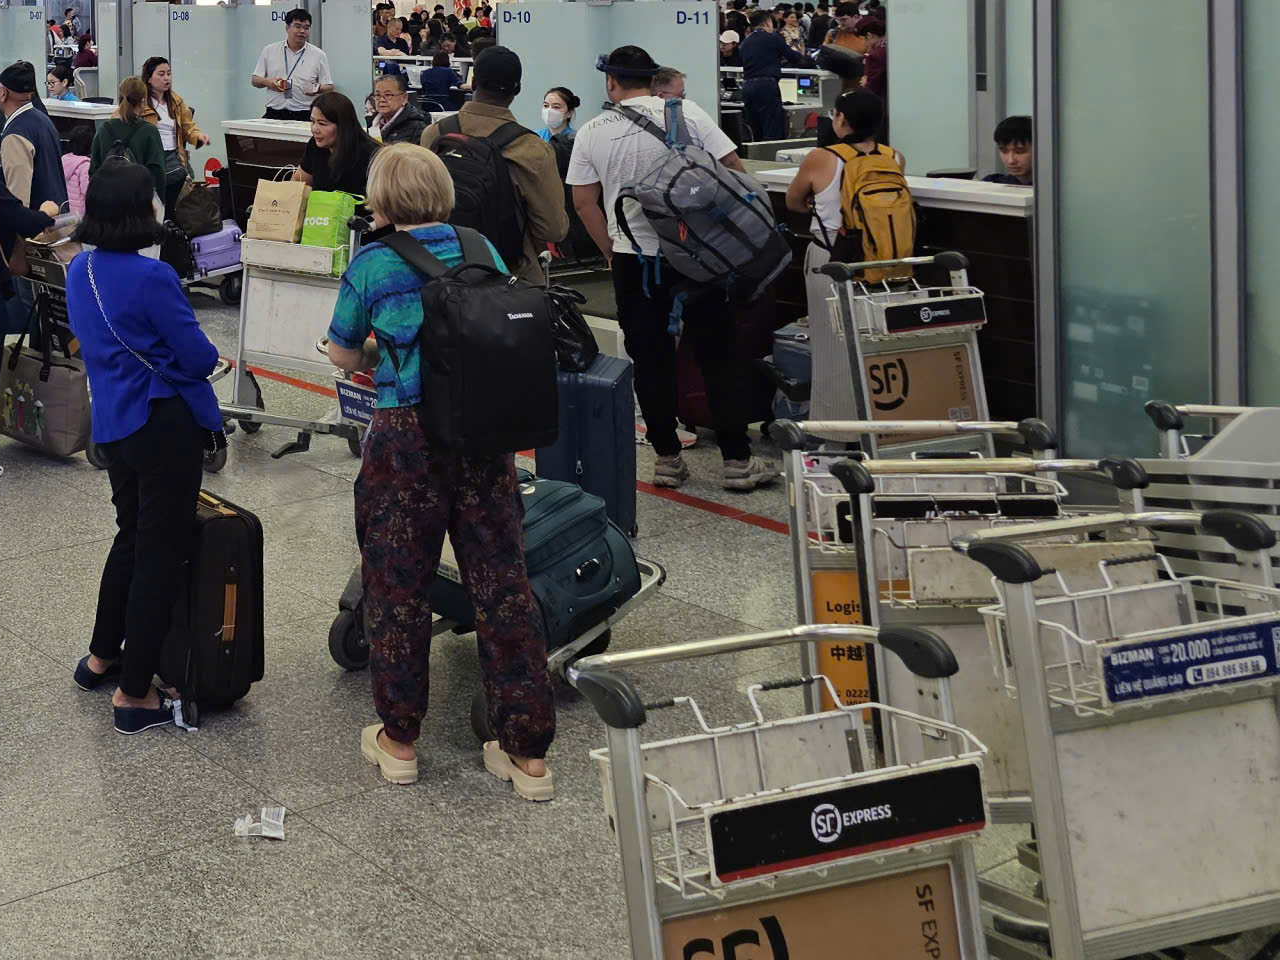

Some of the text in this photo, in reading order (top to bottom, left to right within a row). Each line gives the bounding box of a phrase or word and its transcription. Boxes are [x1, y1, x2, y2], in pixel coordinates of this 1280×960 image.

[29, 11, 42, 20] D-07
[172, 11, 190, 21] D-08
[271, 11, 287, 21] D-0
[503, 11, 531, 23] D-10
[676, 11, 710, 25] D-11
[588, 113, 626, 129] LEONAR
[304, 216, 330, 227] rocs
[826, 600, 862, 616] Logis
[831, 644, 864, 662] 中越
[1110, 647, 1155, 666] BIZMAN
[1170, 638, 1211, 663] 20.000
[845, 688, 869, 699] 0222
[842, 804, 892, 827] EXPRESS
[915, 884, 943, 960] SF EXP
